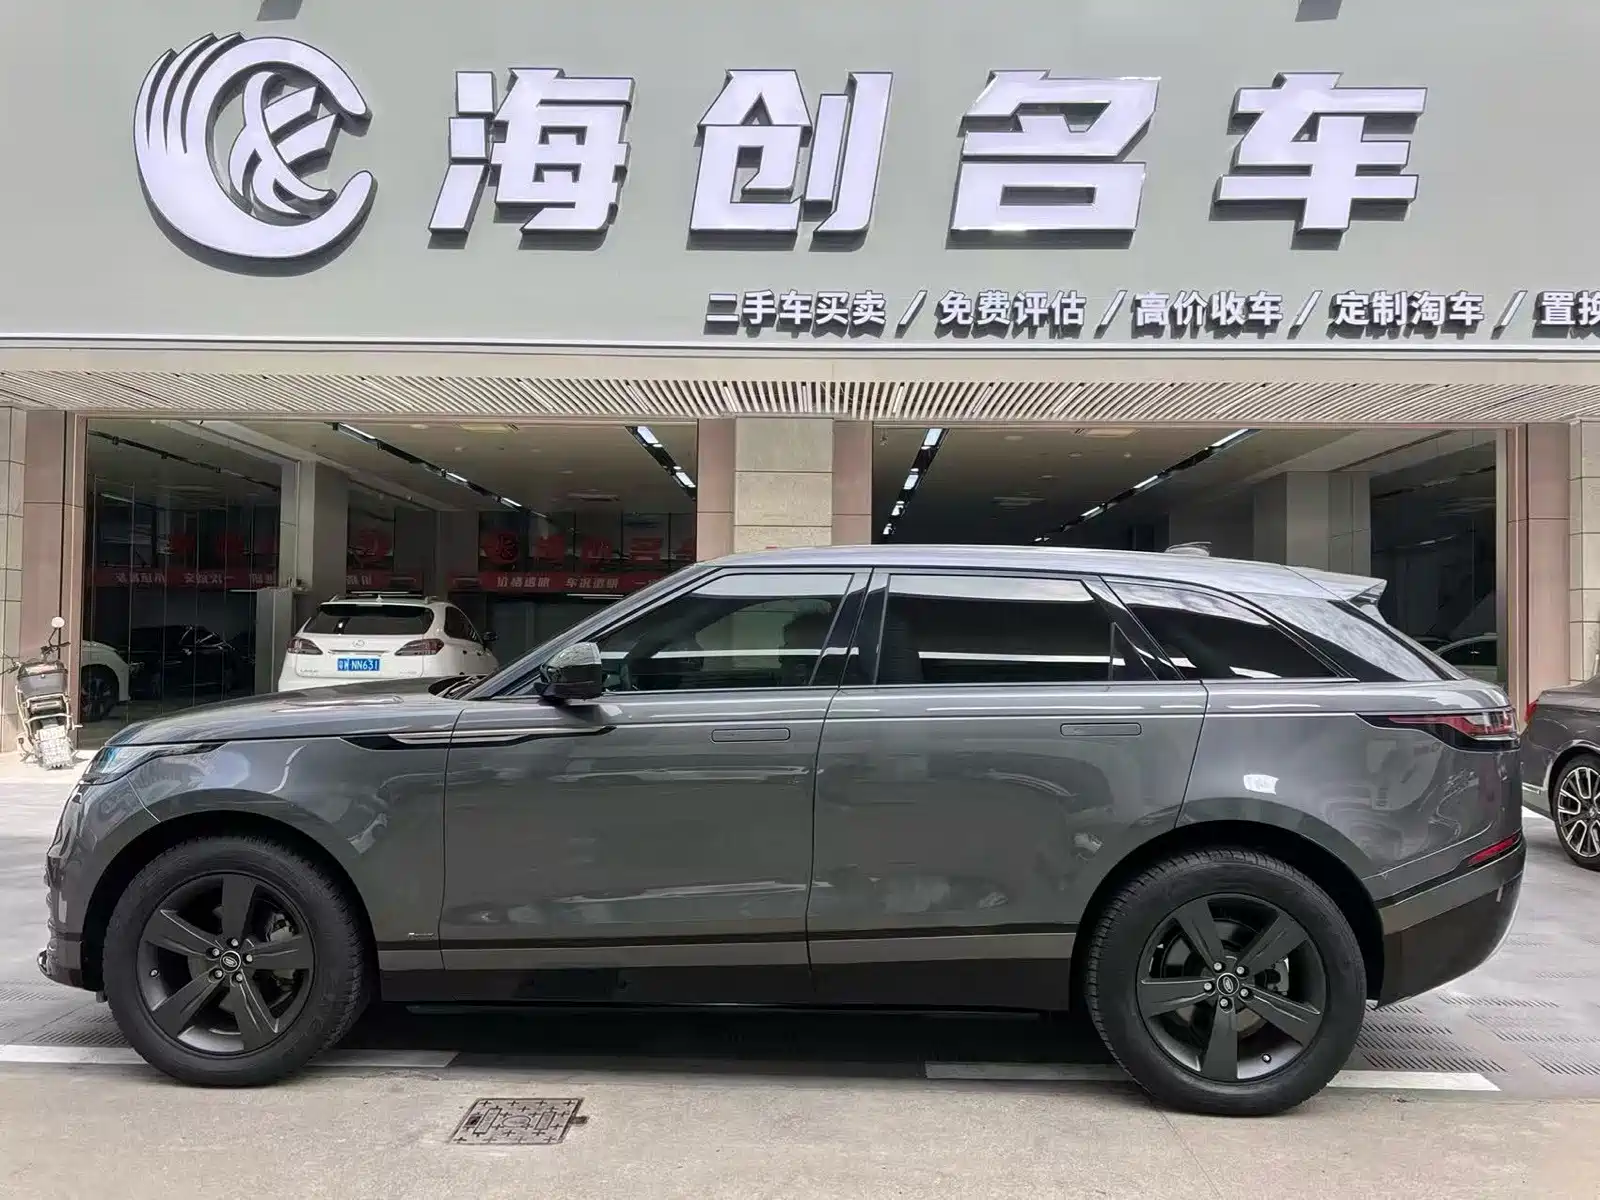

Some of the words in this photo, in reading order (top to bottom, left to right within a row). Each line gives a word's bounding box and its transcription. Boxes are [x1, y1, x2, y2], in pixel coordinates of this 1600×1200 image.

[428, 67, 1428, 234] 海创名车
[706, 290, 888, 326] 二手车买卖
[939, 290, 1086, 326] 免费评估
[1134, 290, 1283, 326] 高价收车
[1335, 290, 1484, 326] 定制淘车
